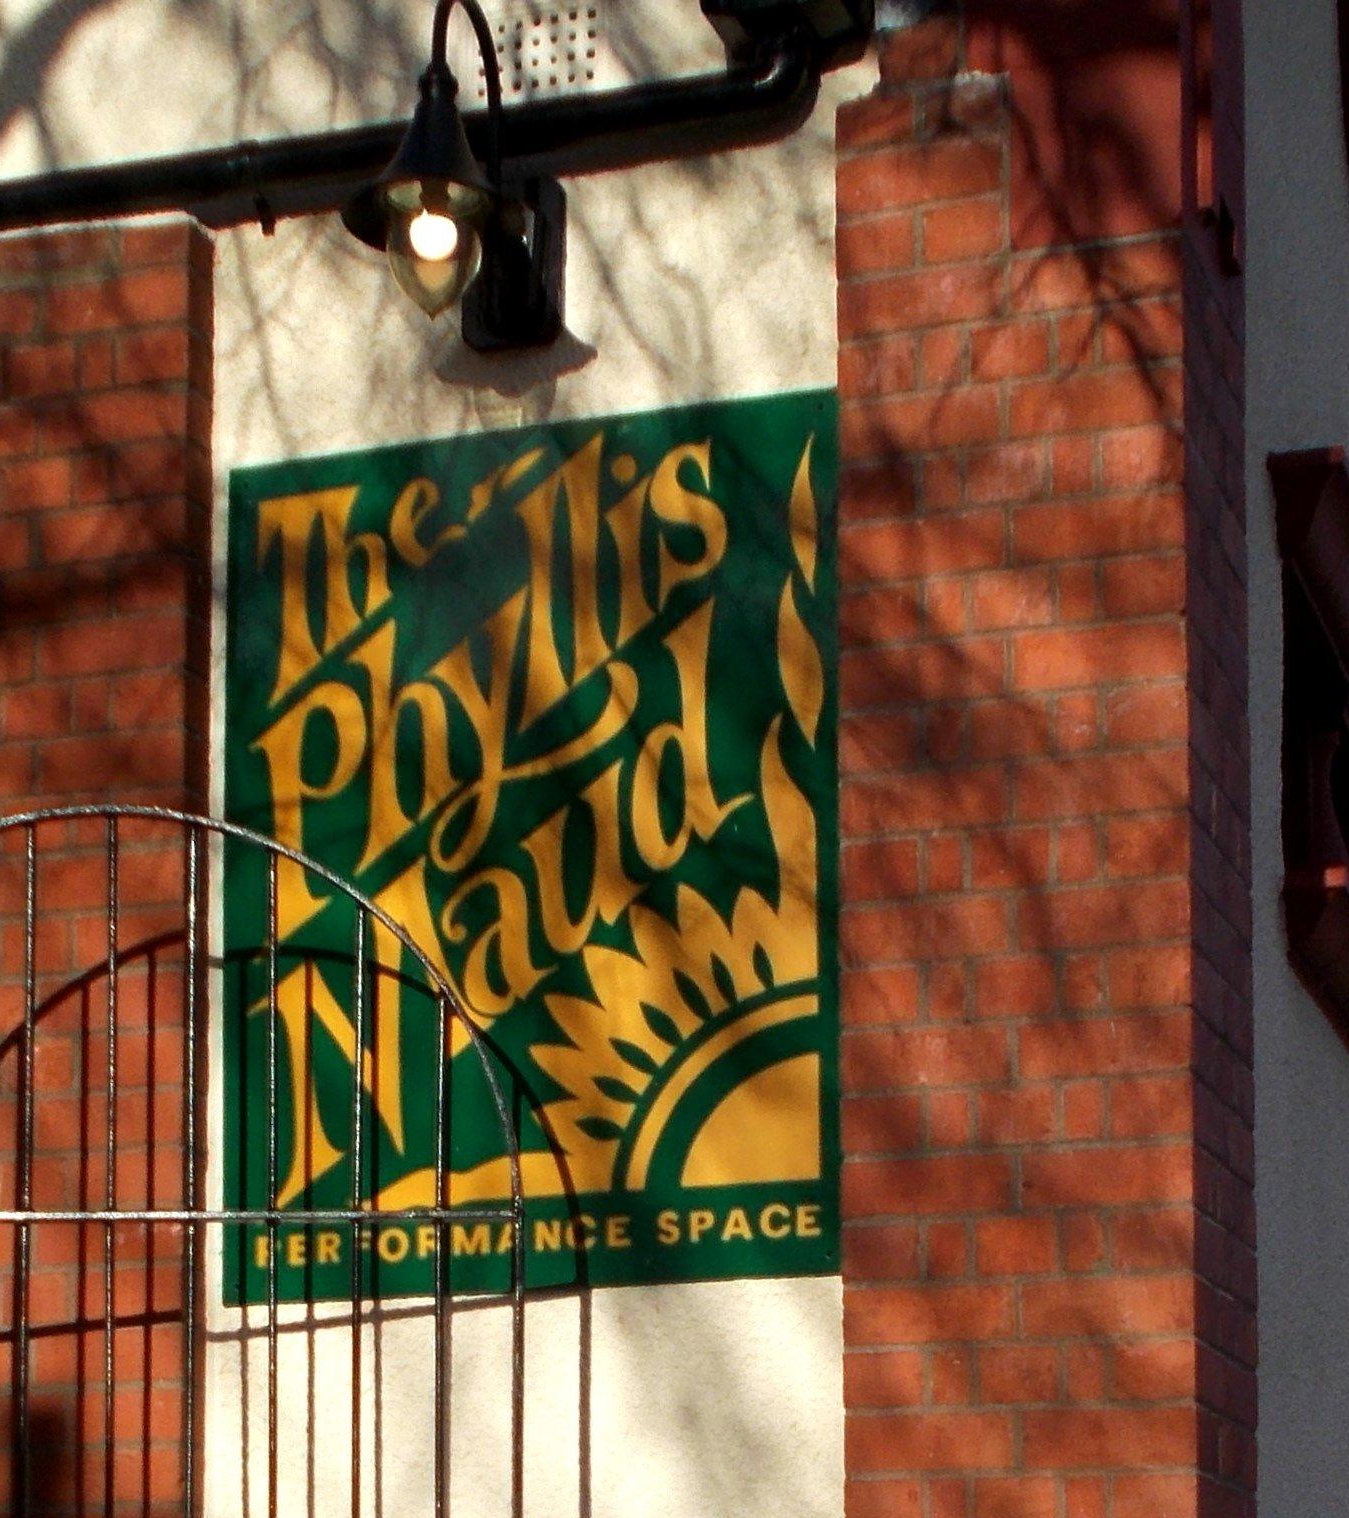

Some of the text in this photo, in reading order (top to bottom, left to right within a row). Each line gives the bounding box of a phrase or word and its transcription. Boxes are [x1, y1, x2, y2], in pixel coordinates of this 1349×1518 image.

[247, 431, 728, 950] Phyllis
[257, 450, 543, 708] The
[247, 597, 755, 1208] Maud
[655, 1203, 822, 1246] SPACE
